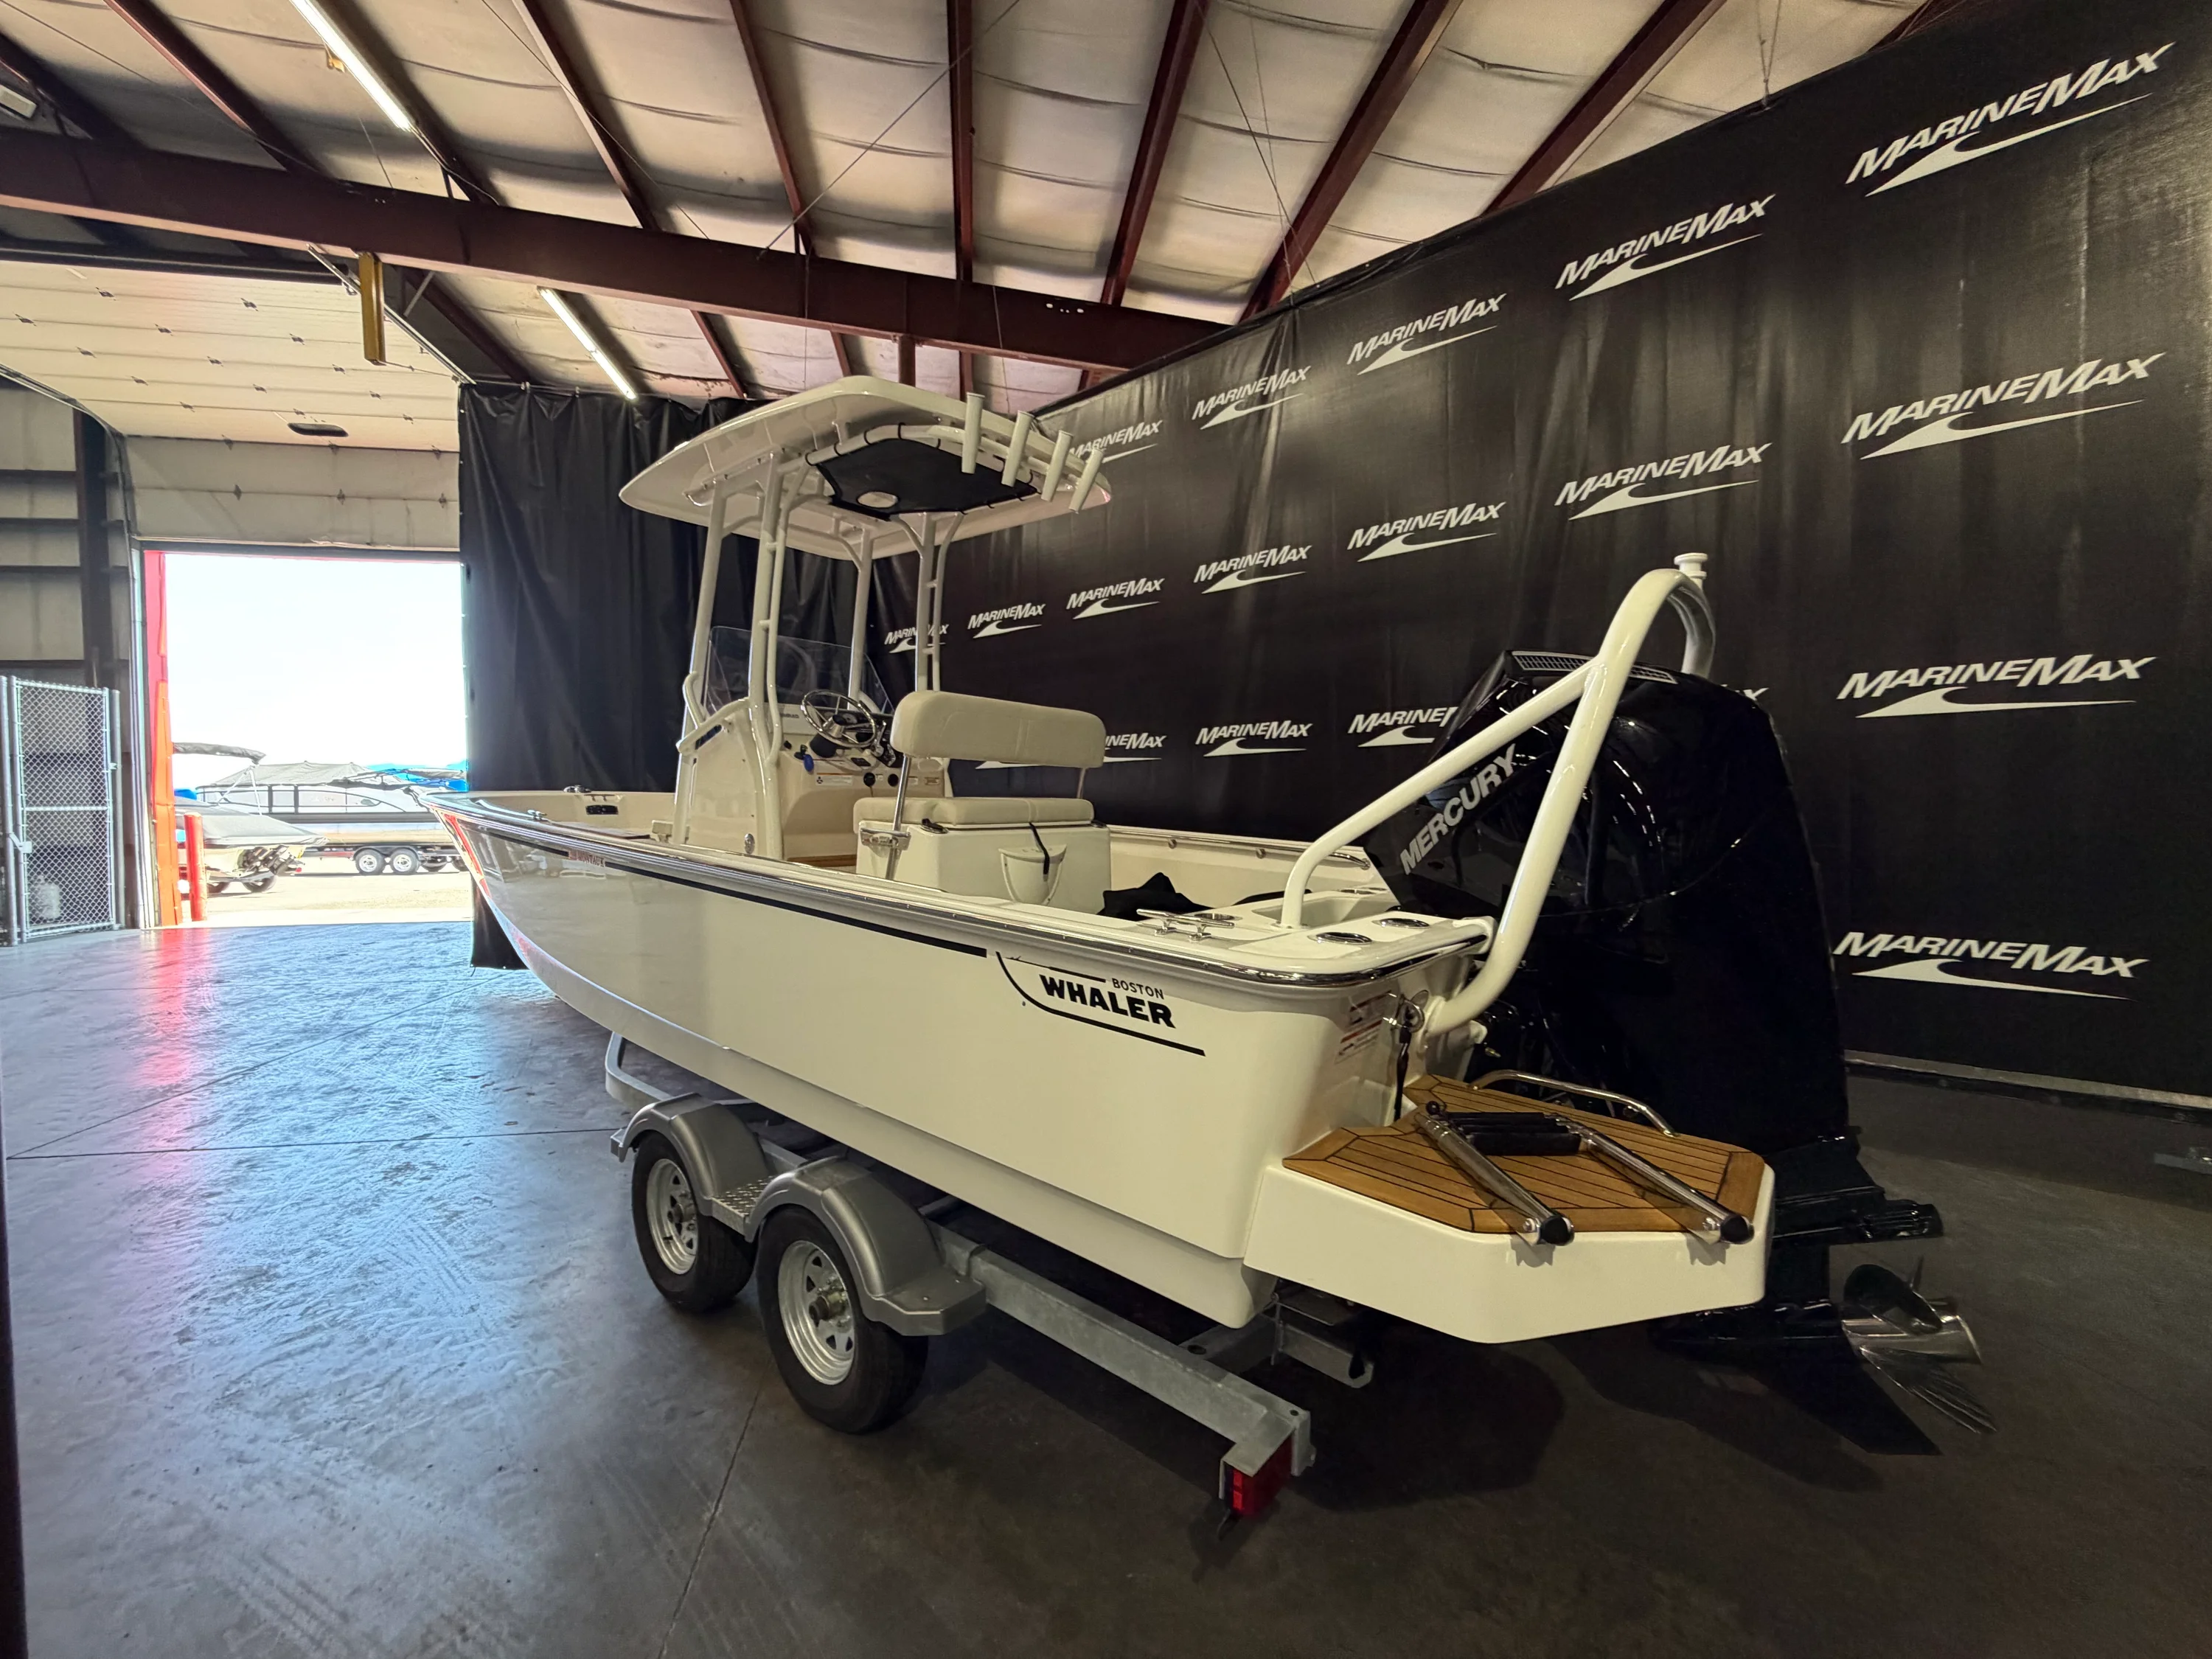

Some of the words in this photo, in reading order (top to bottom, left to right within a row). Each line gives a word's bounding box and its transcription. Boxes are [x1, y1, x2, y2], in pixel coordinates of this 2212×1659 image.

[1846, 42, 2174, 184] MARINEMAX
[1555, 195, 1775, 289] MARINEMAX
[1346, 293, 1506, 365] MARINEMAX
[1192, 365, 1312, 420] MARINEMAX
[1840, 352, 2166, 444] MARINEMAX
[1554, 442, 1772, 506] MARINEMAX
[1347, 501, 1506, 550] MARINEMAX
[1194, 545, 1312, 583] MARINEMAX
[967, 602, 1046, 630] MARINEMAX
[1066, 577, 1164, 610] MARINEMAX
[884, 624, 950, 645] MARINX
[1837, 654, 2156, 700] MARINEMAX
[1195, 720, 1312, 745] MARINEMAX
[1347, 706, 1459, 734] MARINE
[1400, 743, 1515, 875] MERCURY
[1833, 931, 2148, 978] MARINEMAX
[1039, 973, 1177, 1029] WHALER
[1111, 977, 1165, 1001] BOSTON
